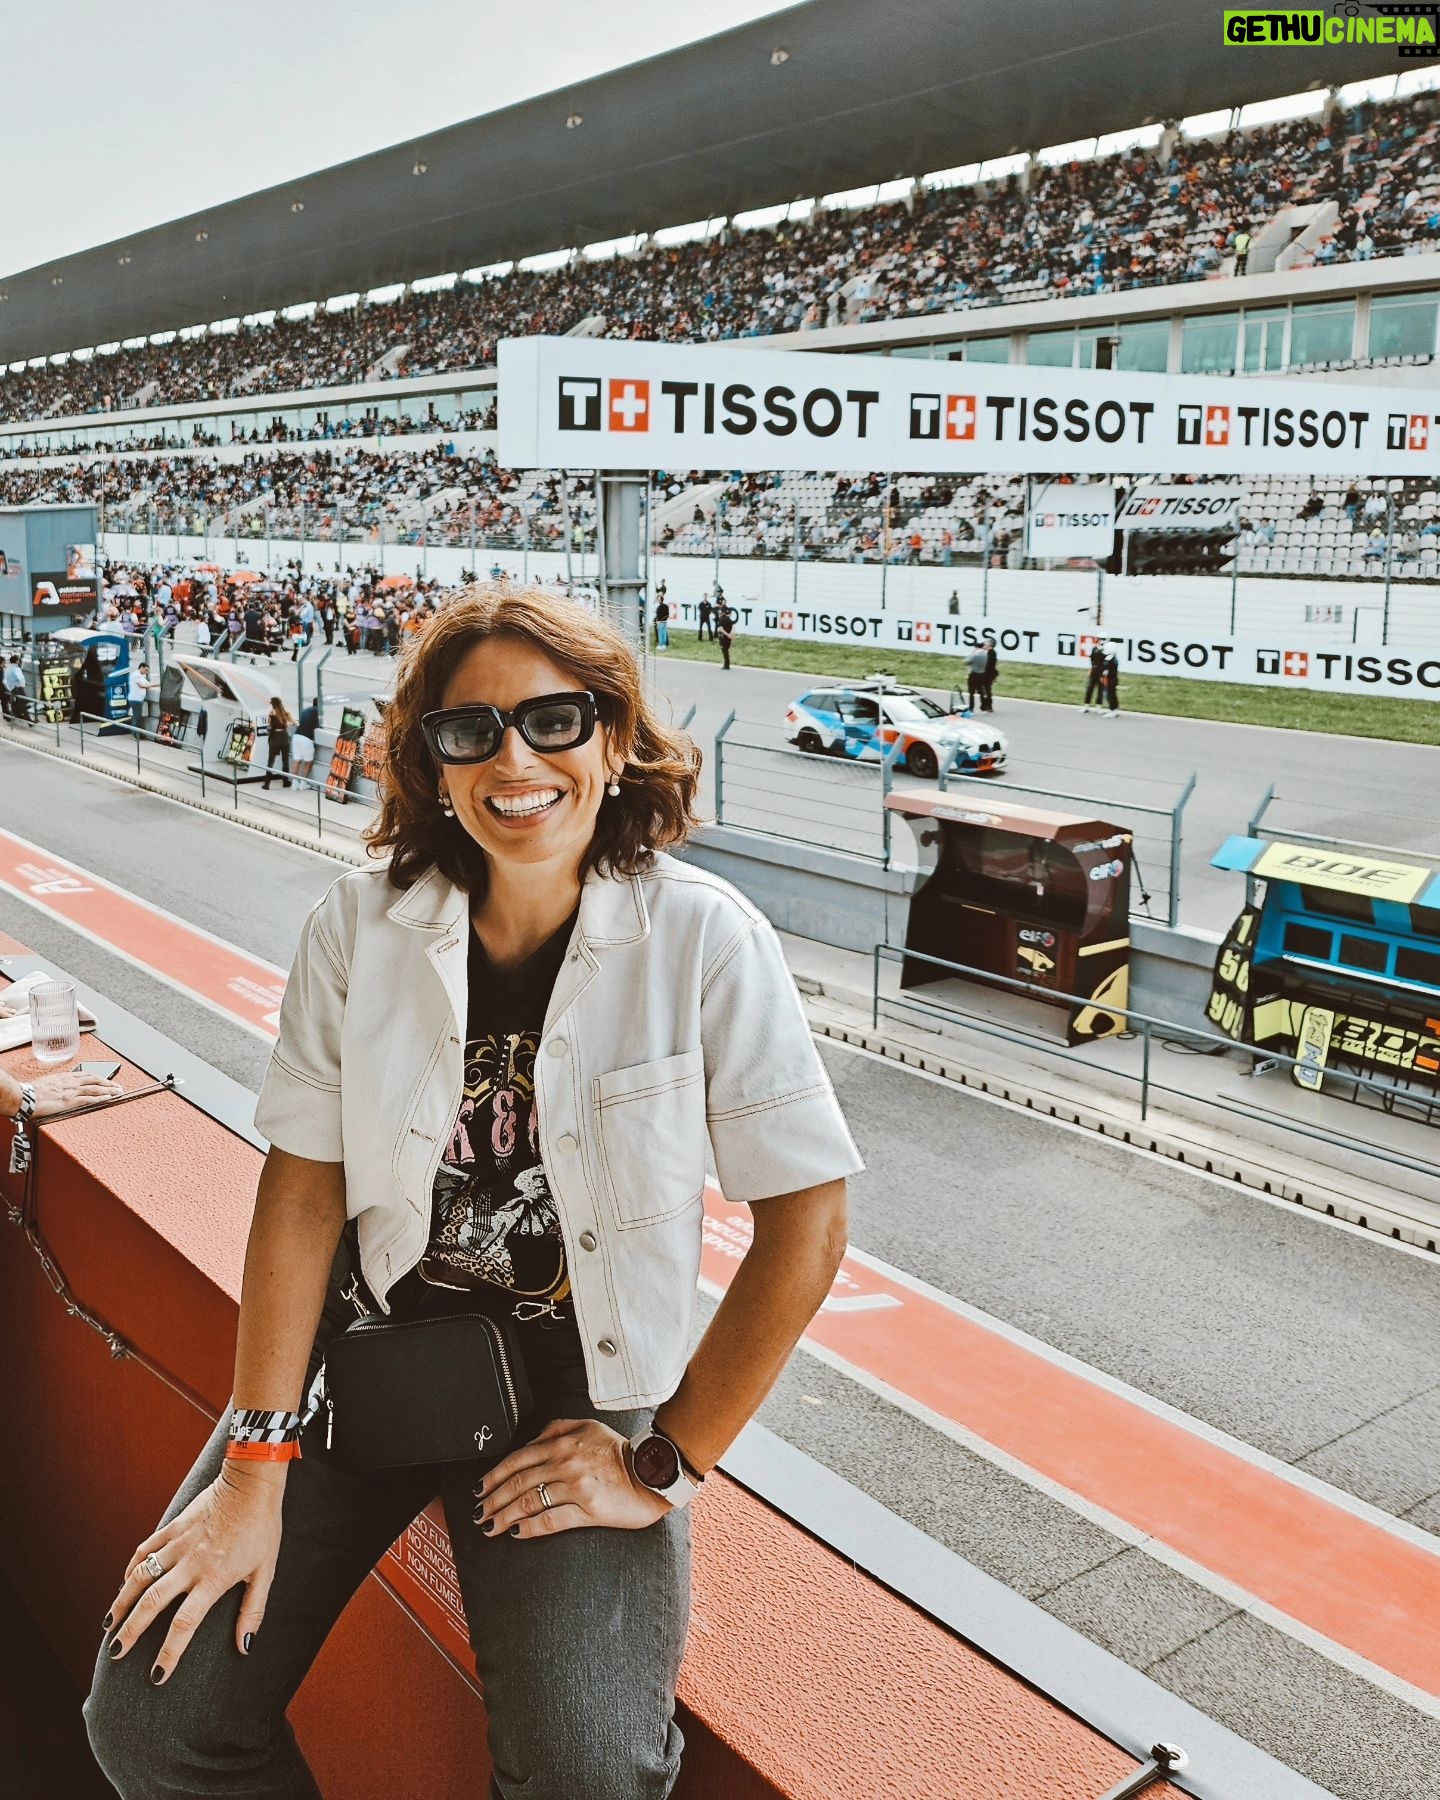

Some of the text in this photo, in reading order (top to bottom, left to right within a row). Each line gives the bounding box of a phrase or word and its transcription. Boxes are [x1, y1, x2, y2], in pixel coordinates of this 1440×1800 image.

[661, 380, 879, 438] TISSOT
[986, 396, 1154, 444] TISSOT
[1238, 406, 1369, 449] TISSOT
[1057, 513, 1110, 527] TISSOT
[1161, 497, 1240, 516] TISSOT
[681, 603, 752, 627] TIOT
[797, 612, 883, 638] TISSOT
[1316, 653, 1440, 689] TISSO
[1281, 855, 1409, 884] BOE
[407, 1528, 460, 1589] NO SMOKE
[429, 1528, 453, 1559] FUM
[407, 1550, 466, 1618] NON FUMEU
